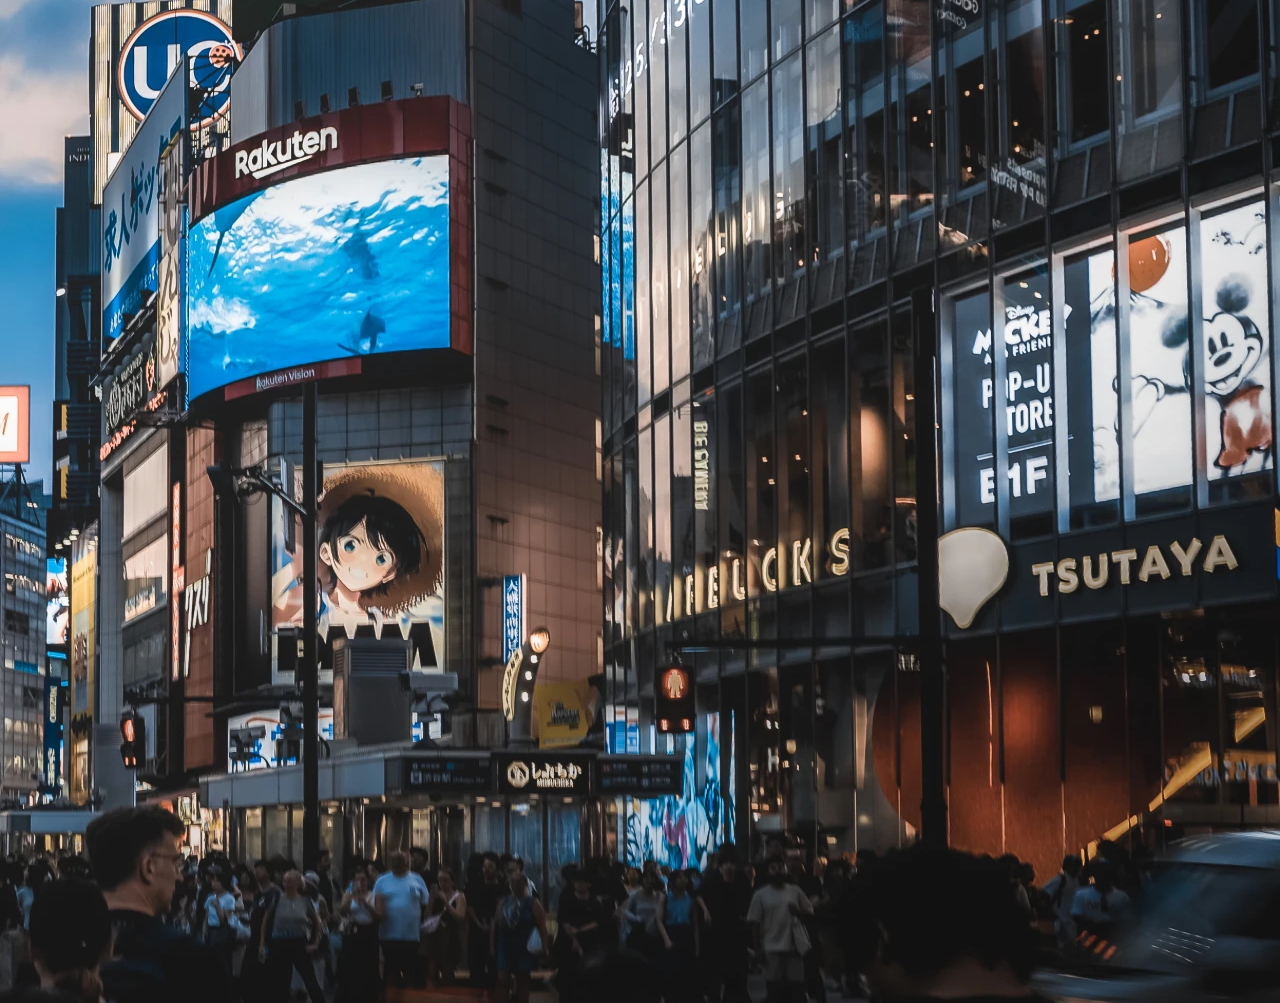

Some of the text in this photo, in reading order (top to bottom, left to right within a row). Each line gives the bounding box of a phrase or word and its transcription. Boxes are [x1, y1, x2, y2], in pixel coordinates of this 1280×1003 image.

[235, 126, 338, 179] Rakuten
[972, 303, 1073, 355] MCKE
[256, 368, 315, 391] Rakuten Vision
[982, 362, 1051, 409] PP-U
[1032, 534, 1238, 596] TSUTAYA
